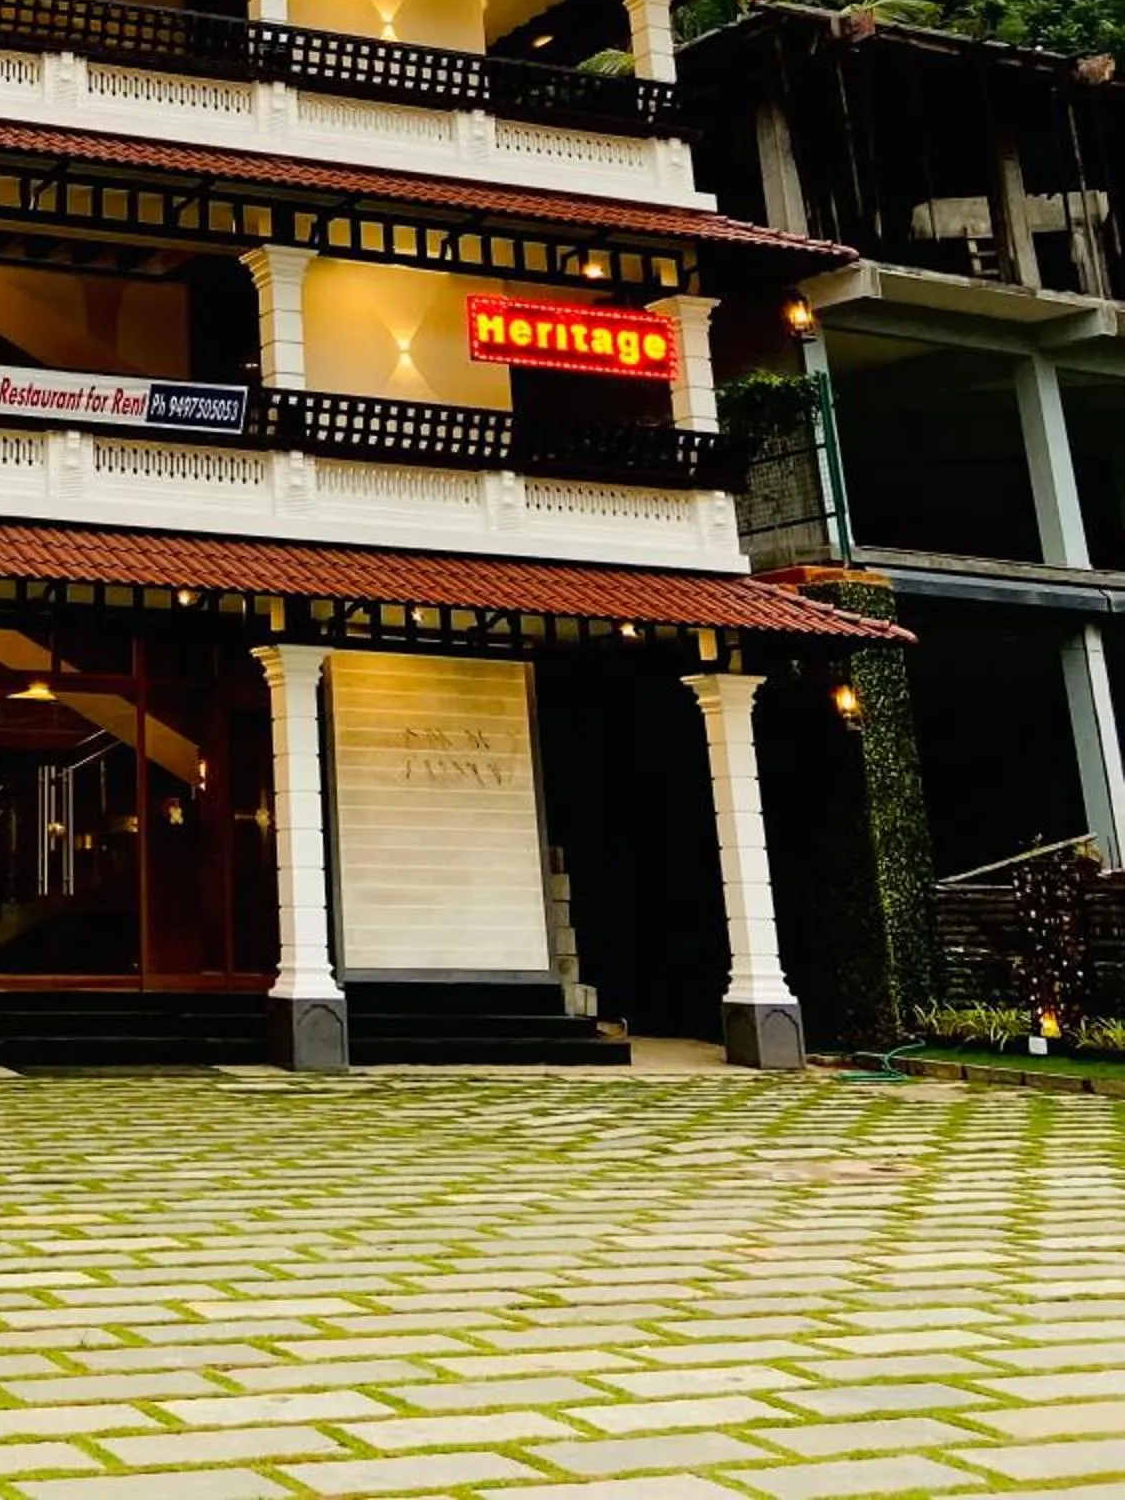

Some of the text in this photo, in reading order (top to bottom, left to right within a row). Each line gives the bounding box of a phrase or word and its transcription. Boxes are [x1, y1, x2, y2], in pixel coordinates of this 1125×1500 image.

[476, 313, 667, 365] Heritage
[84, 385, 109, 413] for
[111, 387, 147, 417] Rent
[150, 393, 166, 416] Ph
